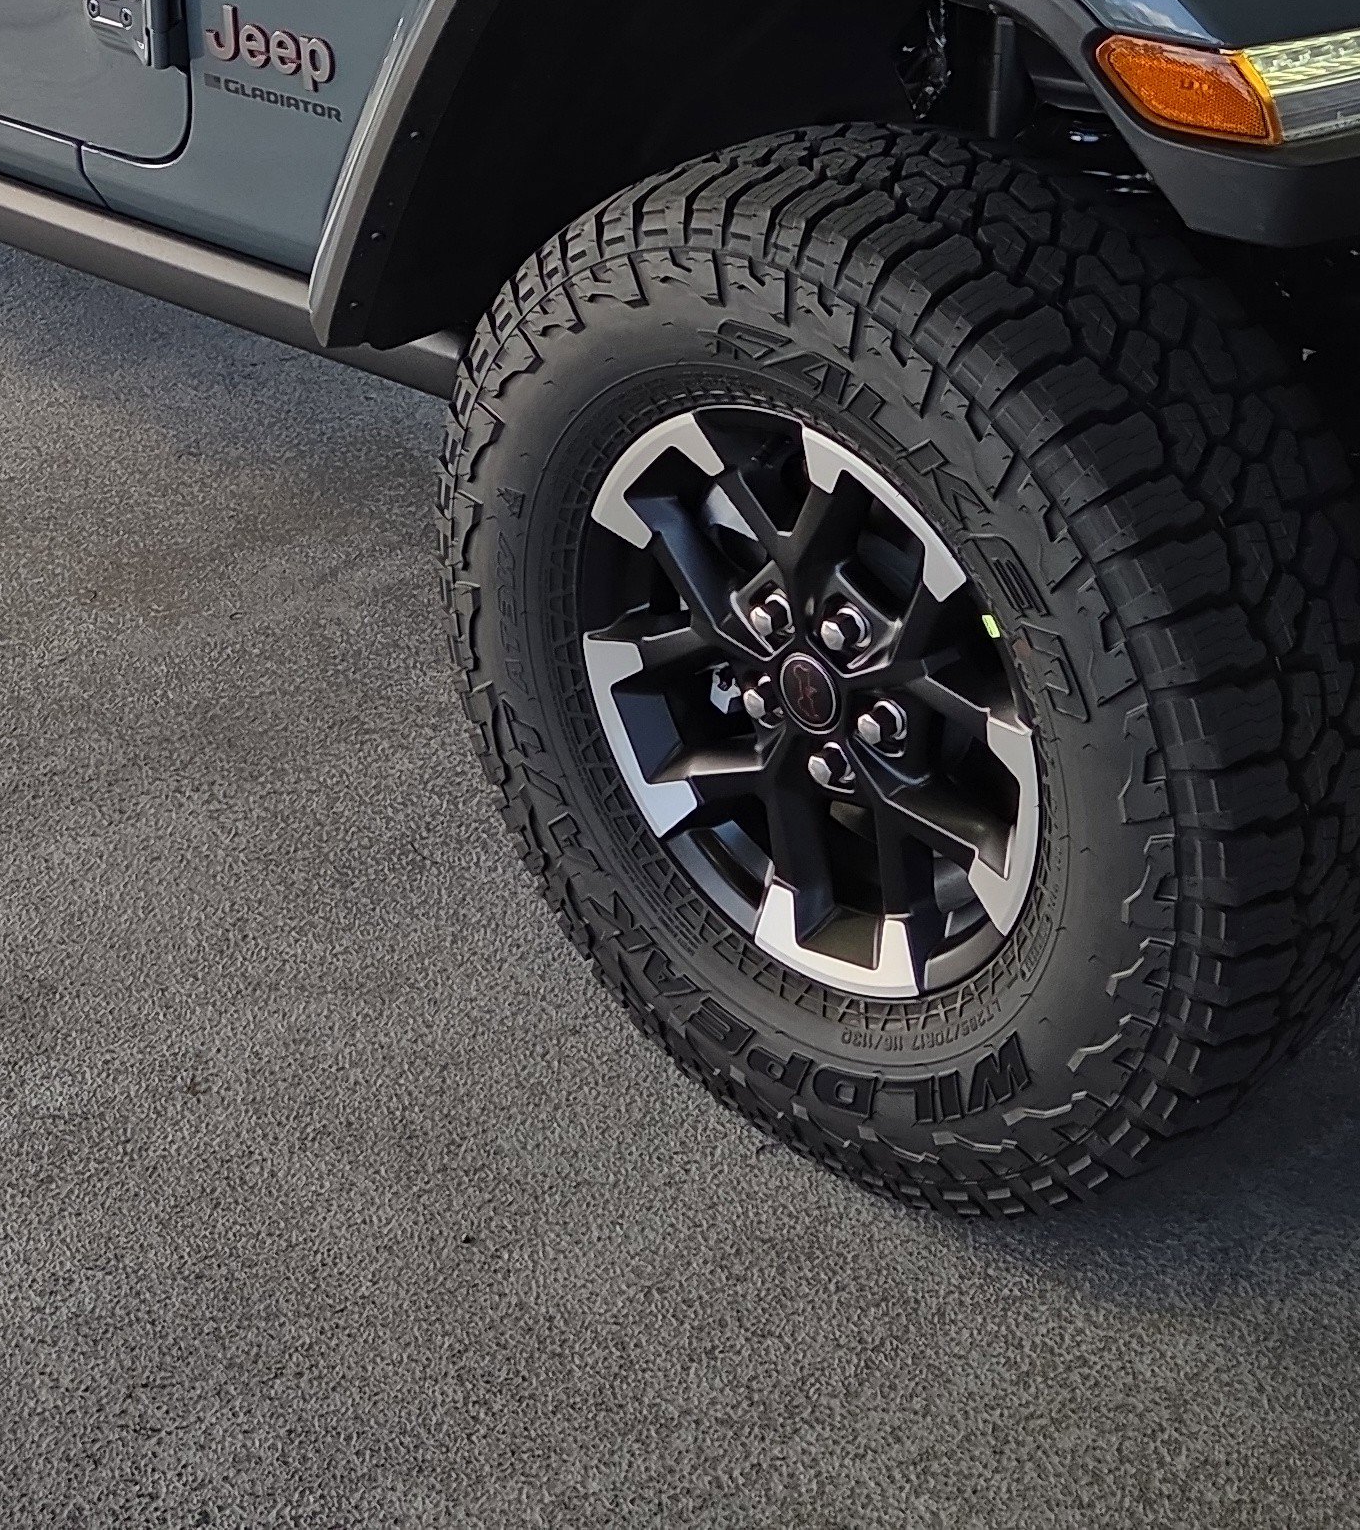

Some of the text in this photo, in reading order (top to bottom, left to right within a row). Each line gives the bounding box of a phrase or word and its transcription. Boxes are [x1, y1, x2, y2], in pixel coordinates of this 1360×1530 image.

[205, 3, 336, 93] Jeep
[224, 78, 343, 123] GLADIATOR
[698, 317, 1092, 724] FALKEN
[580, 885, 1031, 1126] WILDPEAK
